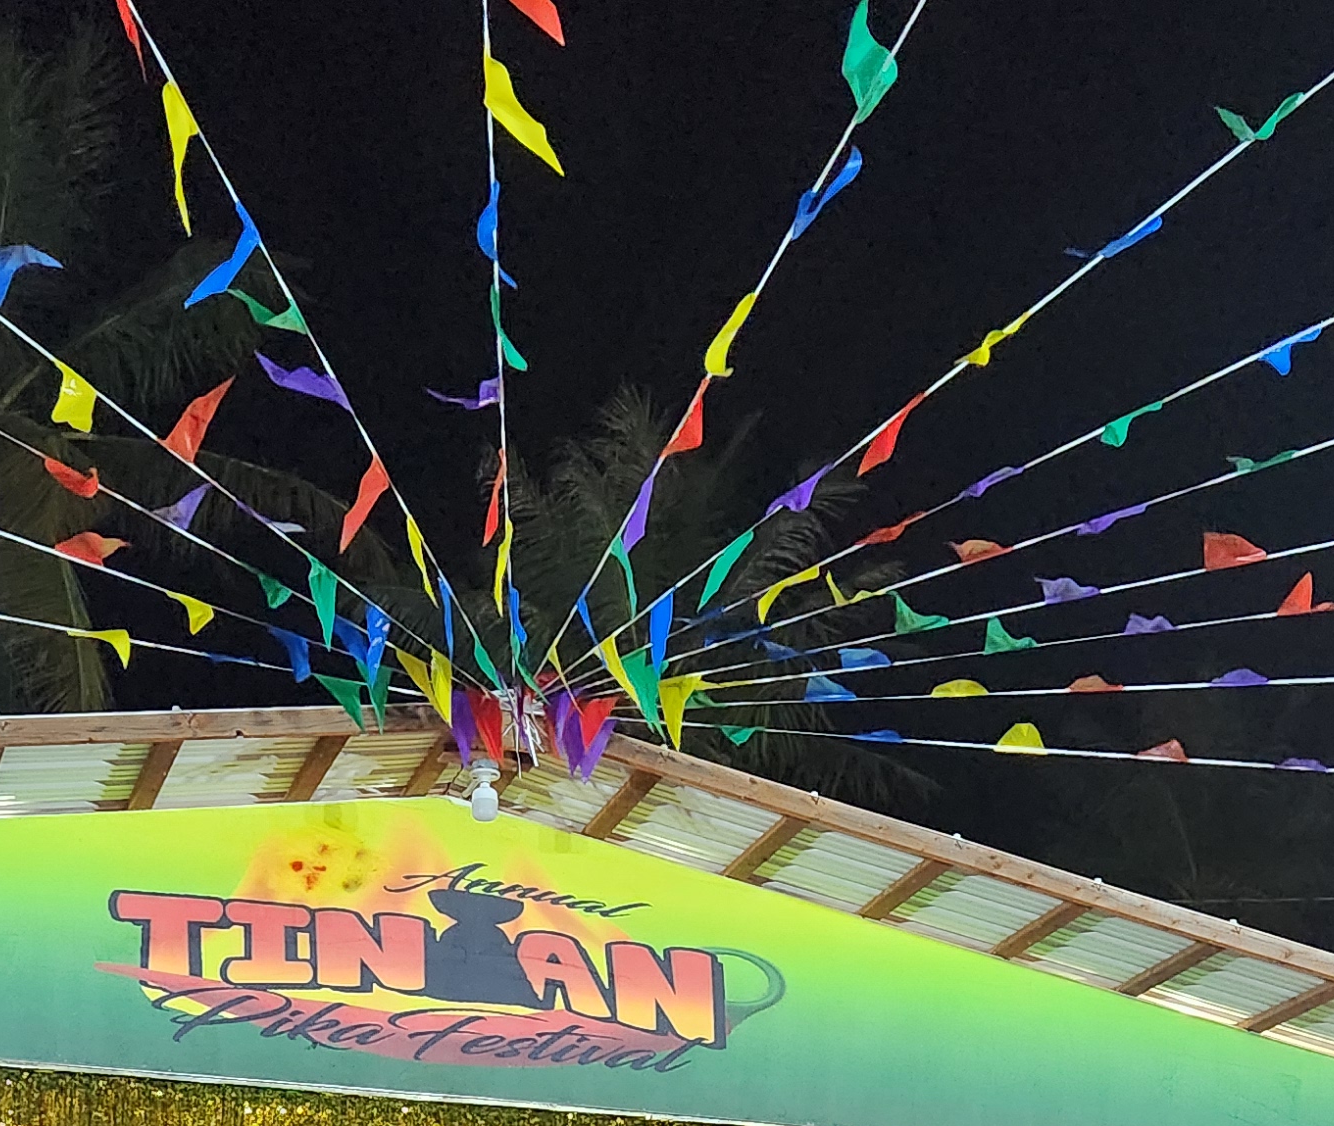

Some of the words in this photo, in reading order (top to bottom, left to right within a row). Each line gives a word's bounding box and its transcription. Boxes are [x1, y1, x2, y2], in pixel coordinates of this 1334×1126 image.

[384, 862, 652, 919] Annual
[139, 980, 395, 1050] Pika
[387, 1006, 692, 1074] Festival
